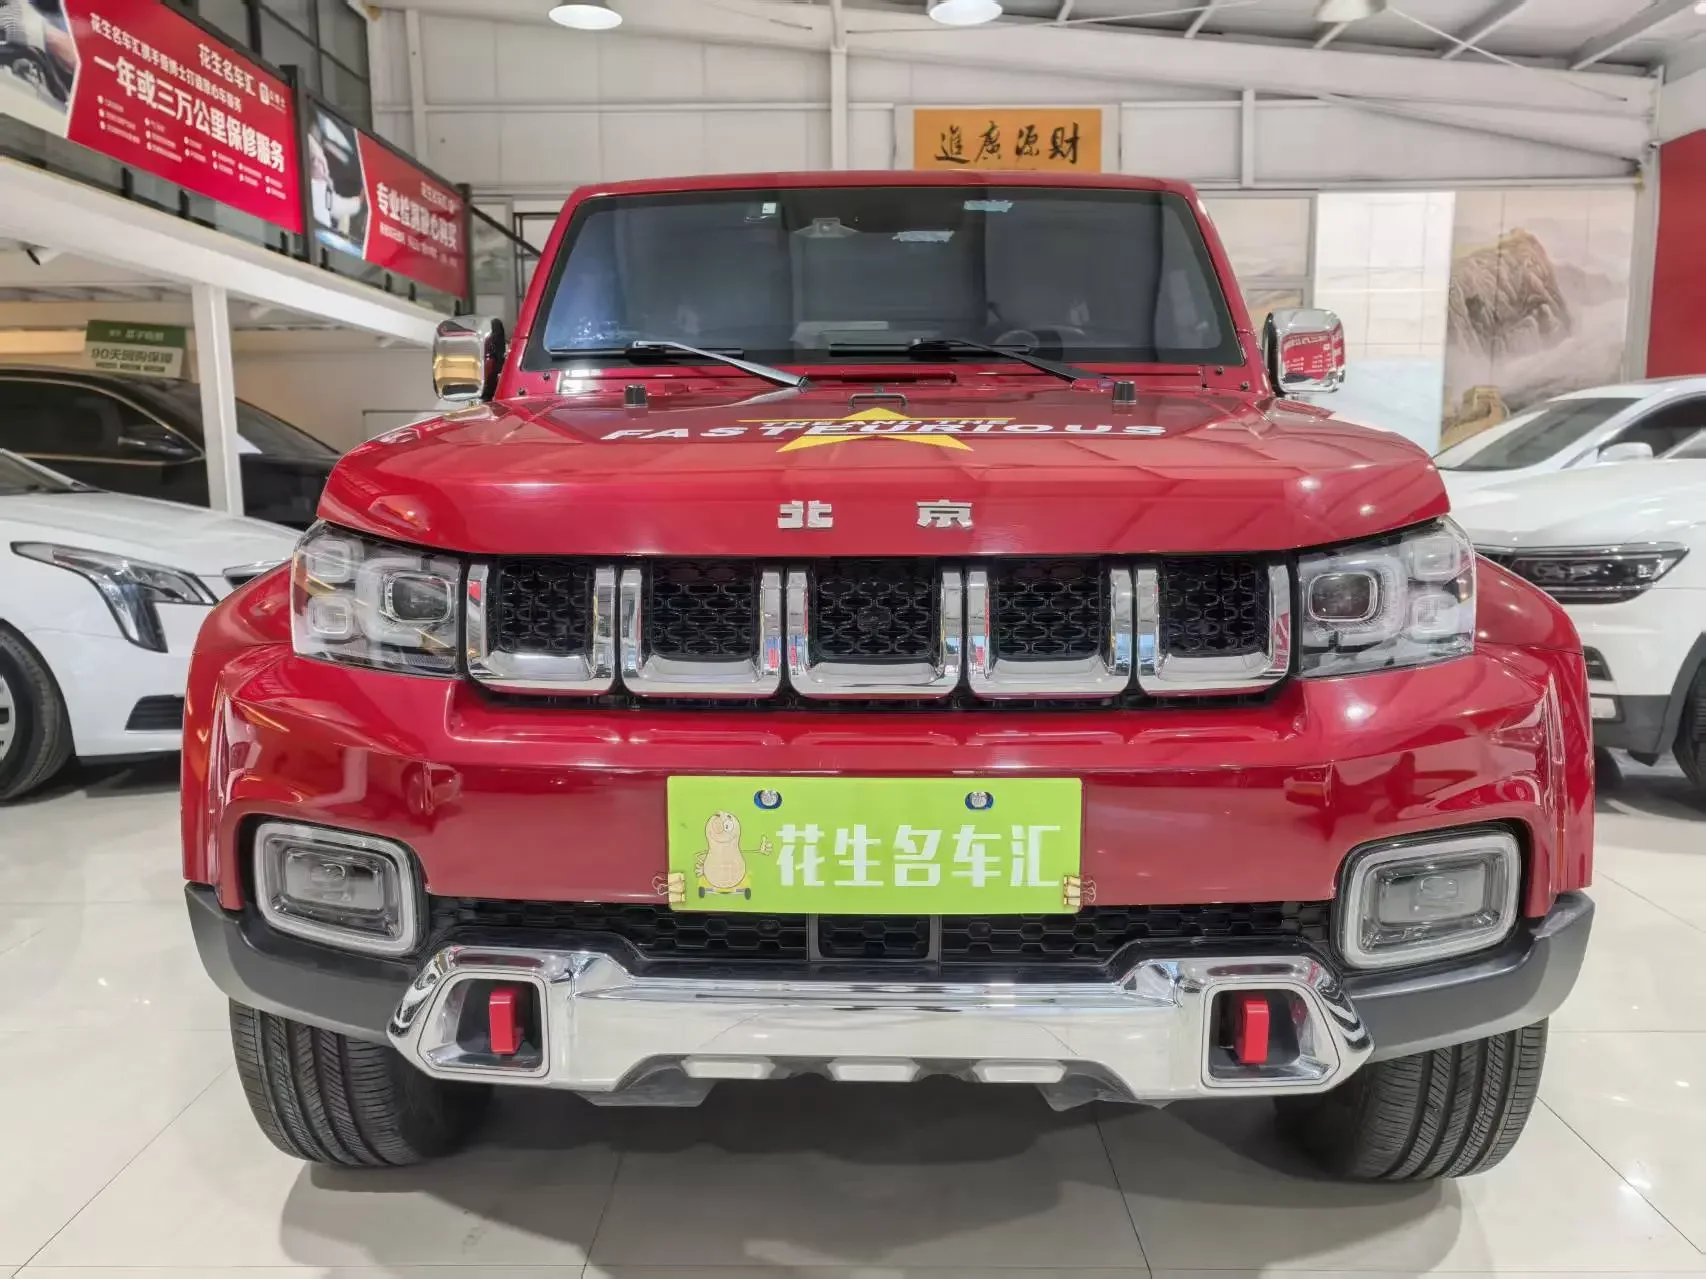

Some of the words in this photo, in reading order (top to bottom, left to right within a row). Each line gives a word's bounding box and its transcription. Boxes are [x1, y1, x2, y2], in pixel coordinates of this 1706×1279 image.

[197, 43, 256, 97] 花生名车汇
[93, 56, 285, 173] 一年或三万公里保修服务
[777, 500, 974, 528] 北京
[776, 823, 1061, 888] 花生名车汇
